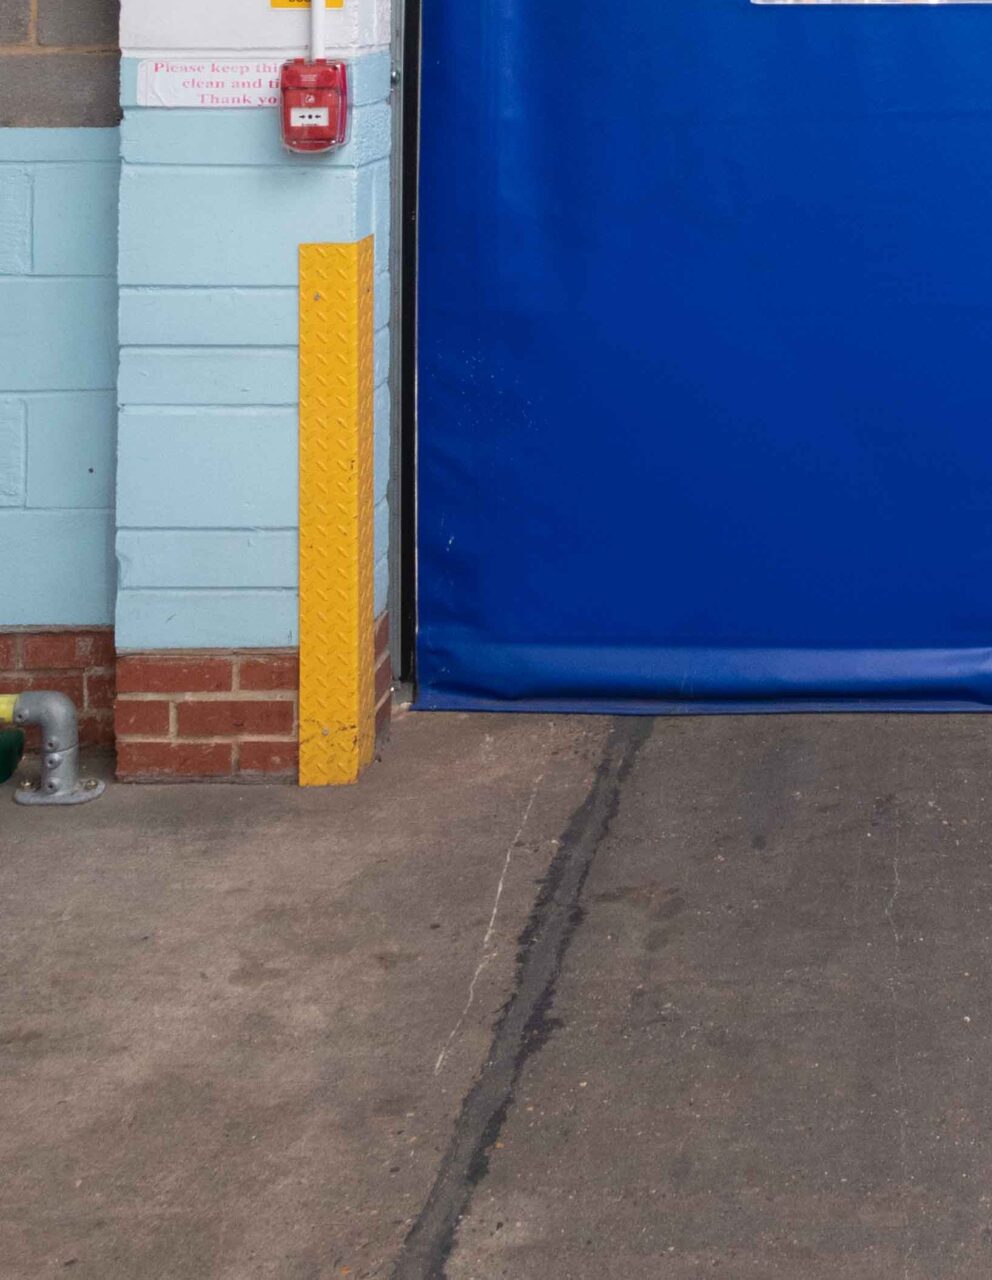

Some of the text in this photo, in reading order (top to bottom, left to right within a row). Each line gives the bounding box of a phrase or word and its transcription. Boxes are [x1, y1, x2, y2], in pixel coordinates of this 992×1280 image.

[154, 62, 279, 76] Please keep thi
[181, 78, 225, 89] clean
[231, 78, 262, 89] and
[200, 93, 279, 107] Thank yo
